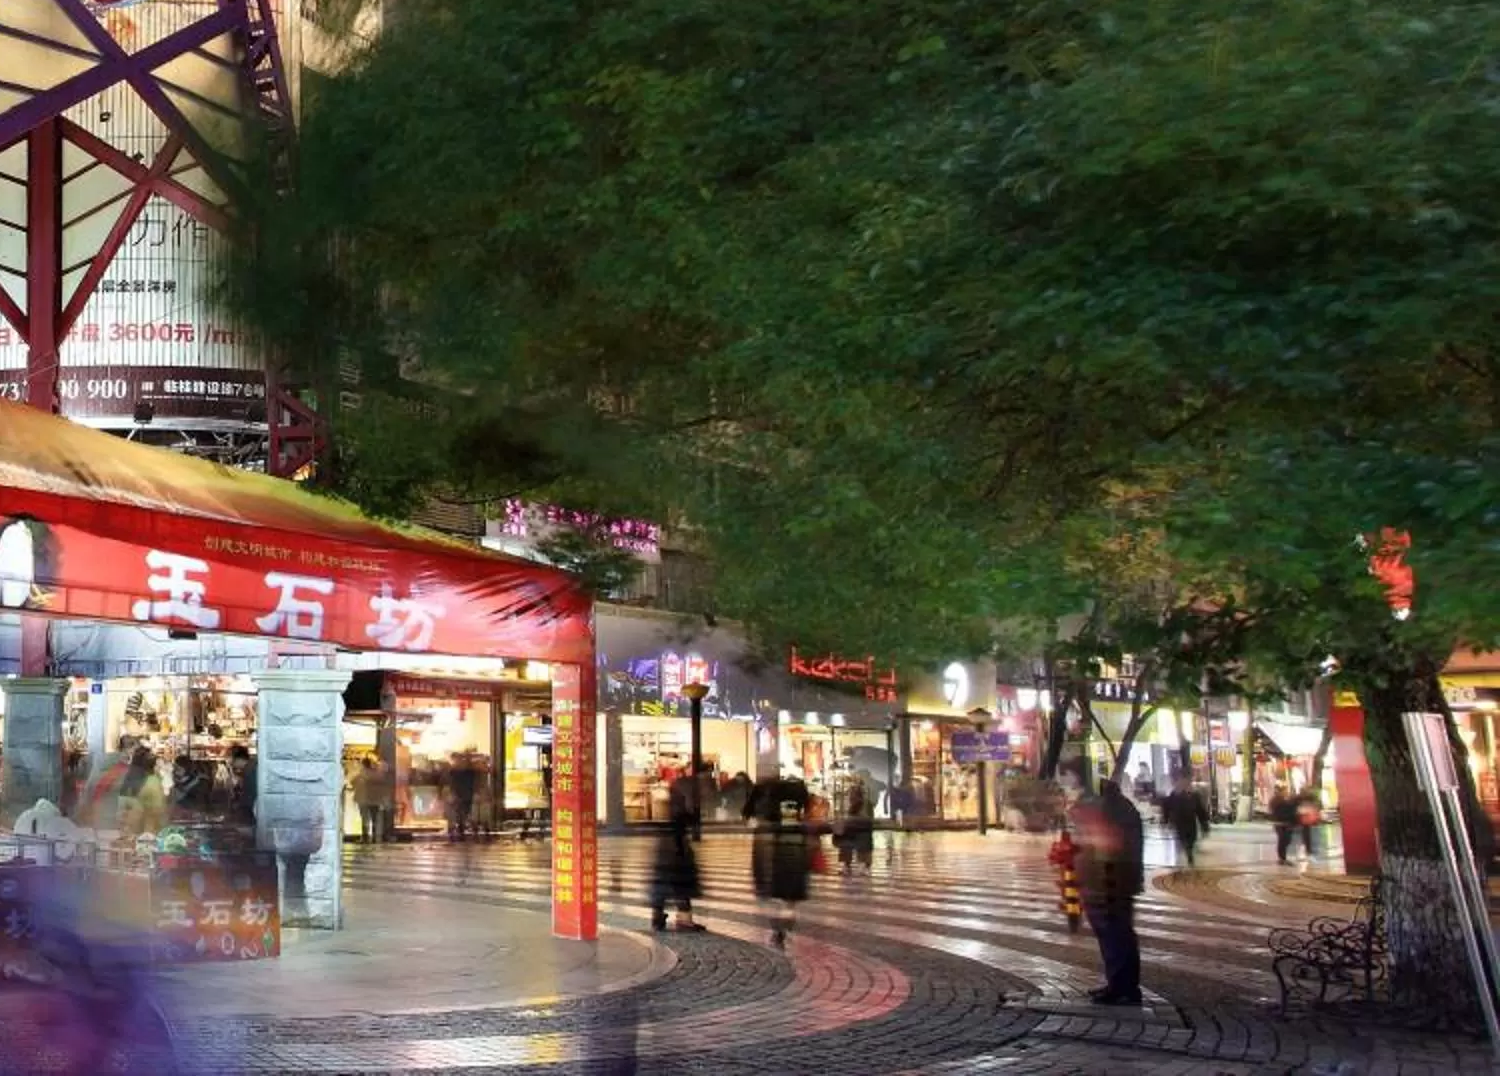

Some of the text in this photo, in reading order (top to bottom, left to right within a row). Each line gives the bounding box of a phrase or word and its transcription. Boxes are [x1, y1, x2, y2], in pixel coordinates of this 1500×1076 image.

[109, 323, 195, 343] 3600元
[88, 380, 127, 399] 900
[132, 549, 447, 652] 玉石坊
[157, 896, 275, 928] 玉石坊
